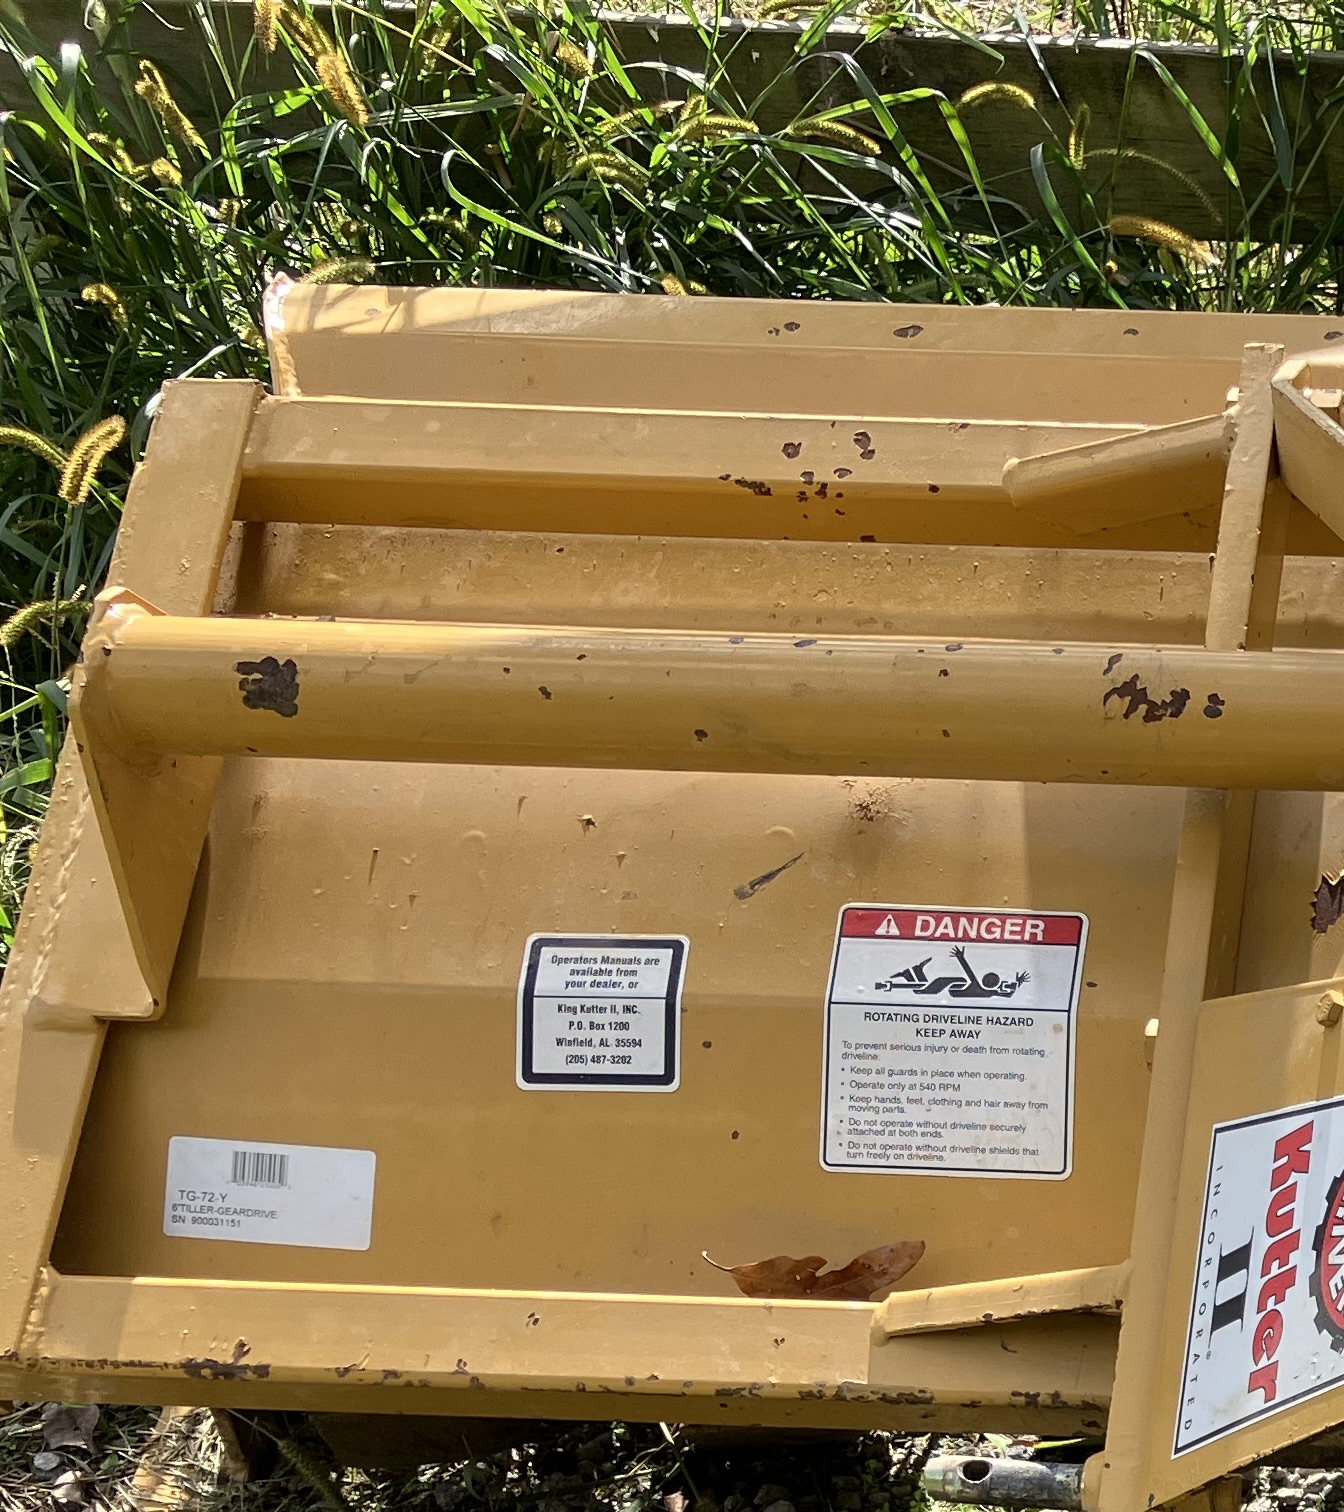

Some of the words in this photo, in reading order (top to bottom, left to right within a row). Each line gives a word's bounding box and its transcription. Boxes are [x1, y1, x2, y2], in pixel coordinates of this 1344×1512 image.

[914, 915, 1045, 941] DANGER
[551, 955, 598, 966] Operators
[601, 956, 641, 965] Manuals
[570, 968, 613, 976] available
[616, 968, 637, 976] from
[565, 981, 587, 989] your
[590, 980, 624, 990] dealer,
[558, 1004, 577, 1015] King
[580, 1005, 607, 1014] Kutter
[623, 1005, 641, 1014] INC.
[864, 1012, 919, 1023] ROTATING
[923, 1014, 983, 1025] DRIVELINE
[986, 1016, 1034, 1027] HAZARD
[569, 1021, 586, 1030] P.O.
[589, 1021, 605, 1030] Box
[609, 1022, 629, 1030] 1200
[916, 1028, 946, 1037] KEEP
[949, 1029, 981, 1039] AWAY
[615, 1039, 642, 1048] 35594
[842, 1041, 852, 1049] To
[855, 1042, 887, 1051] prevent
[890, 1043, 921, 1051] serious
[924, 1044, 948, 1054] injury
[962, 1045, 987, 1053] death
[990, 1046, 1009, 1054] from
[1013, 1048, 1045, 1058] rotating
[566, 1055, 588, 1065] (205)
[591, 1055, 632, 1064] 487-3202
[850, 1066, 872, 1076] Keep
[888, 1068, 917, 1077] guards
[931, 1069, 954, 1078] place
[957, 1070, 980, 1078] when
[850, 1080, 885, 1090] Operate
[888, 1083, 906, 1092] only
[919, 1083, 936, 1091] 540
[939, 1083, 961, 1092] RPM
[850, 1095, 872, 1105] Keep
[928, 1098, 962, 1109] clothing
[965, 1099, 981, 1107] and
[984, 1099, 1001, 1107] hair
[1003, 1102, 1026, 1110] away
[1028, 1101, 1048, 1109] from
[848, 1105, 879, 1114] moving
[849, 1117, 861, 1126] Do
[880, 1120, 913, 1129] operate
[916, 1121, 947, 1129] without
[950, 1122, 986, 1130] driveline
[990, 1124, 1026, 1134] securely
[847, 1128, 885, 1136] attached
[899, 1129, 918, 1137] both
[848, 1141, 860, 1149] Do
[863, 1142, 876, 1150] not
[880, 1143, 912, 1152] operate
[916, 1144, 947, 1152] without
[950, 1145, 986, 1154] driveline
[989, 1147, 1019, 1155] shields
[1022, 1148, 1039, 1156] that
[847, 1151, 863, 1159] turn
[867, 1151, 890, 1161] freely
[178, 1190, 228, 1203] TG-72-Y
[171, 1215, 185, 1223] SN
[1248, 1119, 1314, 1404] Kutter
[1184, 1165, 1224, 1430] INCORPORATED
